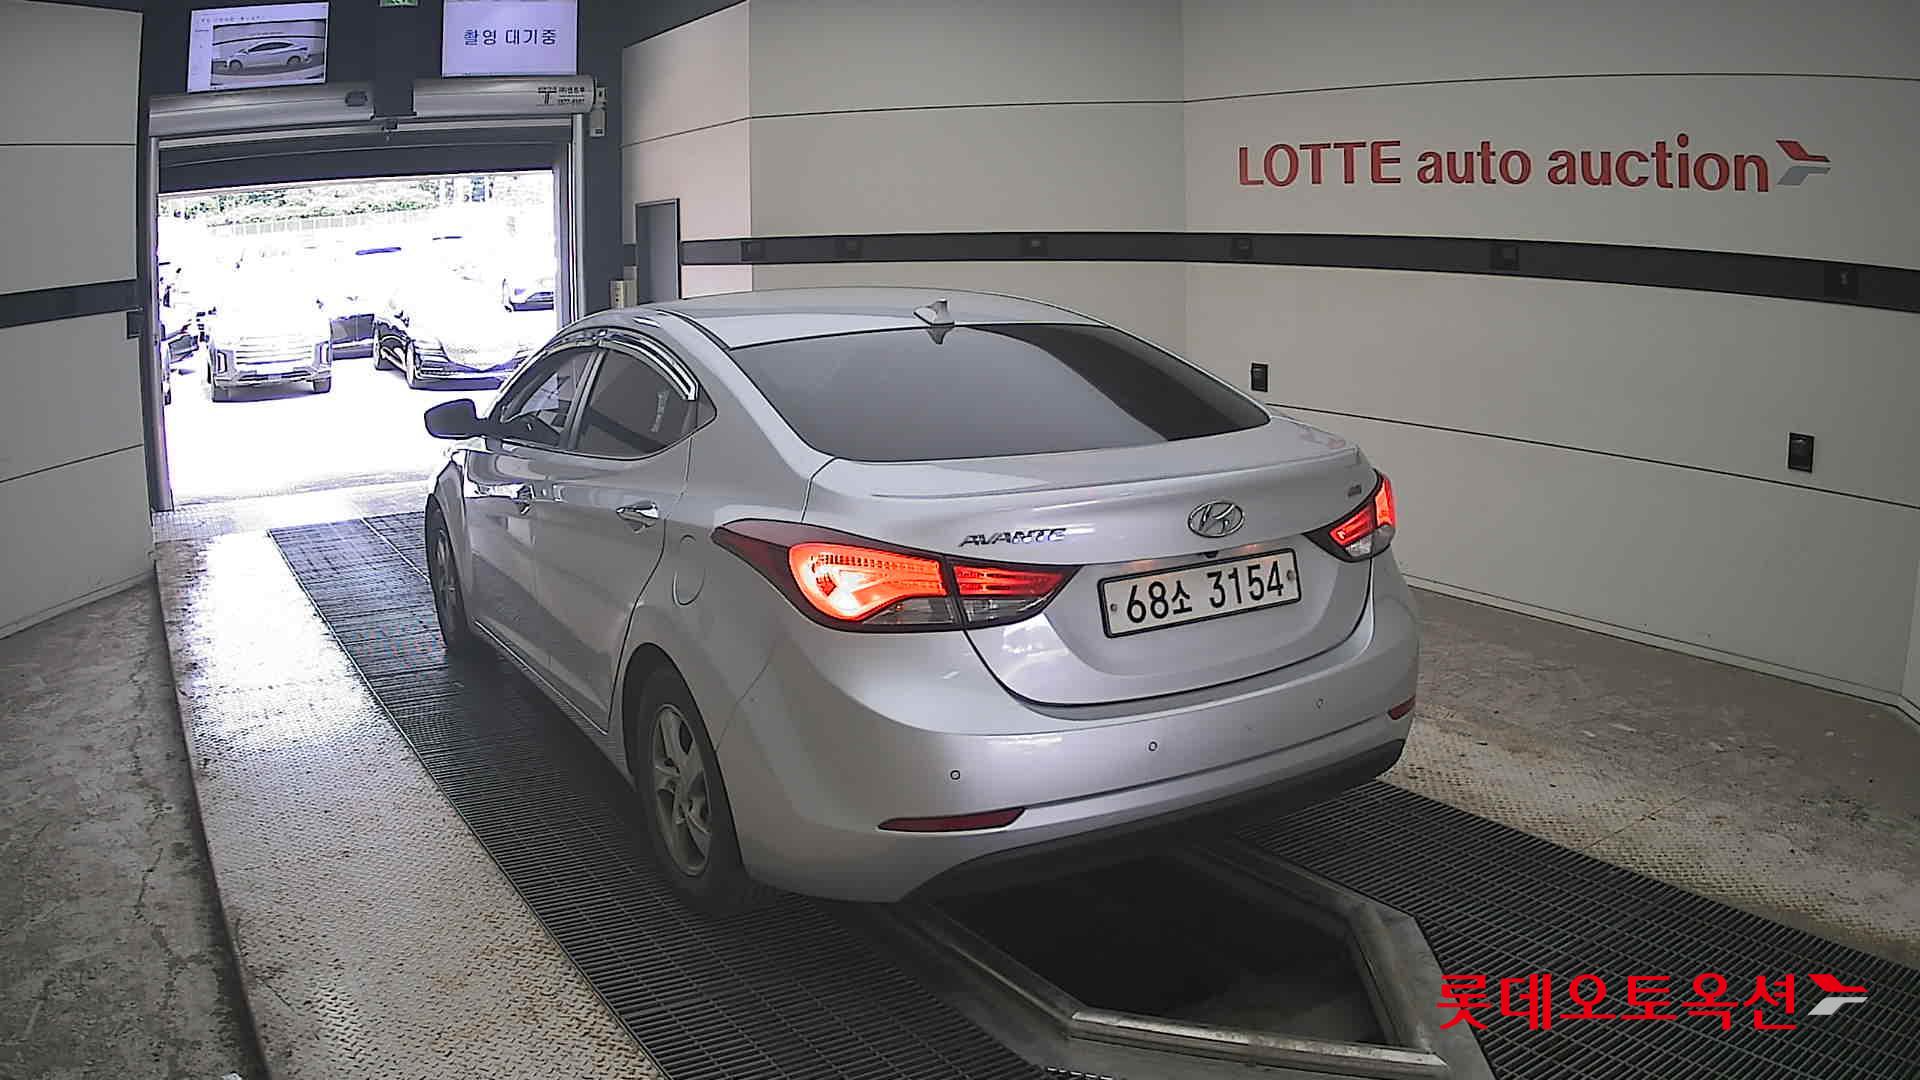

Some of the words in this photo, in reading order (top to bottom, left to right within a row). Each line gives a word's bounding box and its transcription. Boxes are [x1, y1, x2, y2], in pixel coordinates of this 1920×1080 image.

[505, 29, 556, 45] 대기중
[1238, 140, 1402, 187] LOTTE
[1417, 141, 1532, 185] auto
[1548, 133, 1769, 192] auction
[959, 528, 1066, 547] AVANTE
[1126, 580, 1193, 624] 68소
[1206, 560, 1284, 609] 3154
